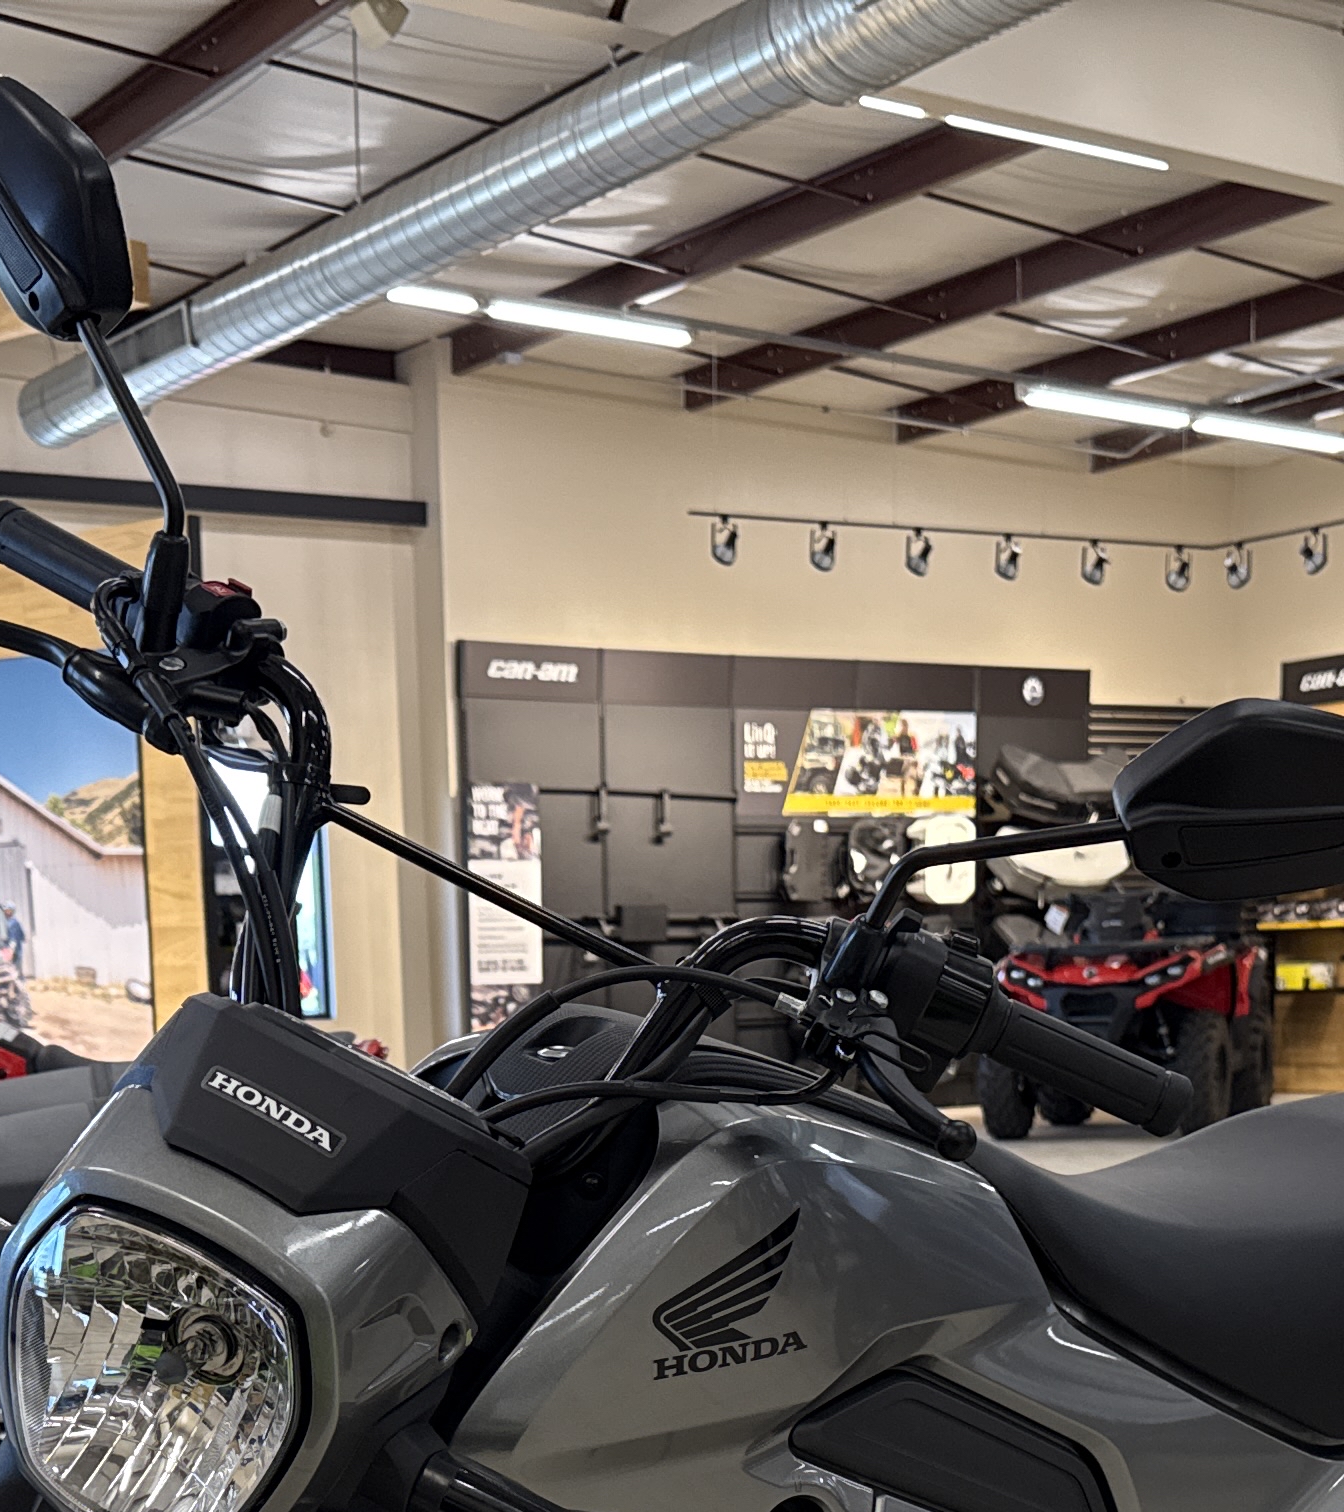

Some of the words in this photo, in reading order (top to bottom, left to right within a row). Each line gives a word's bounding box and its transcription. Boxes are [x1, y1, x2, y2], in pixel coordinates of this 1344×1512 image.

[486, 658, 579, 683] can-am
[208, 1070, 332, 1152] HONDA
[652, 1330, 808, 1381] HONDA
